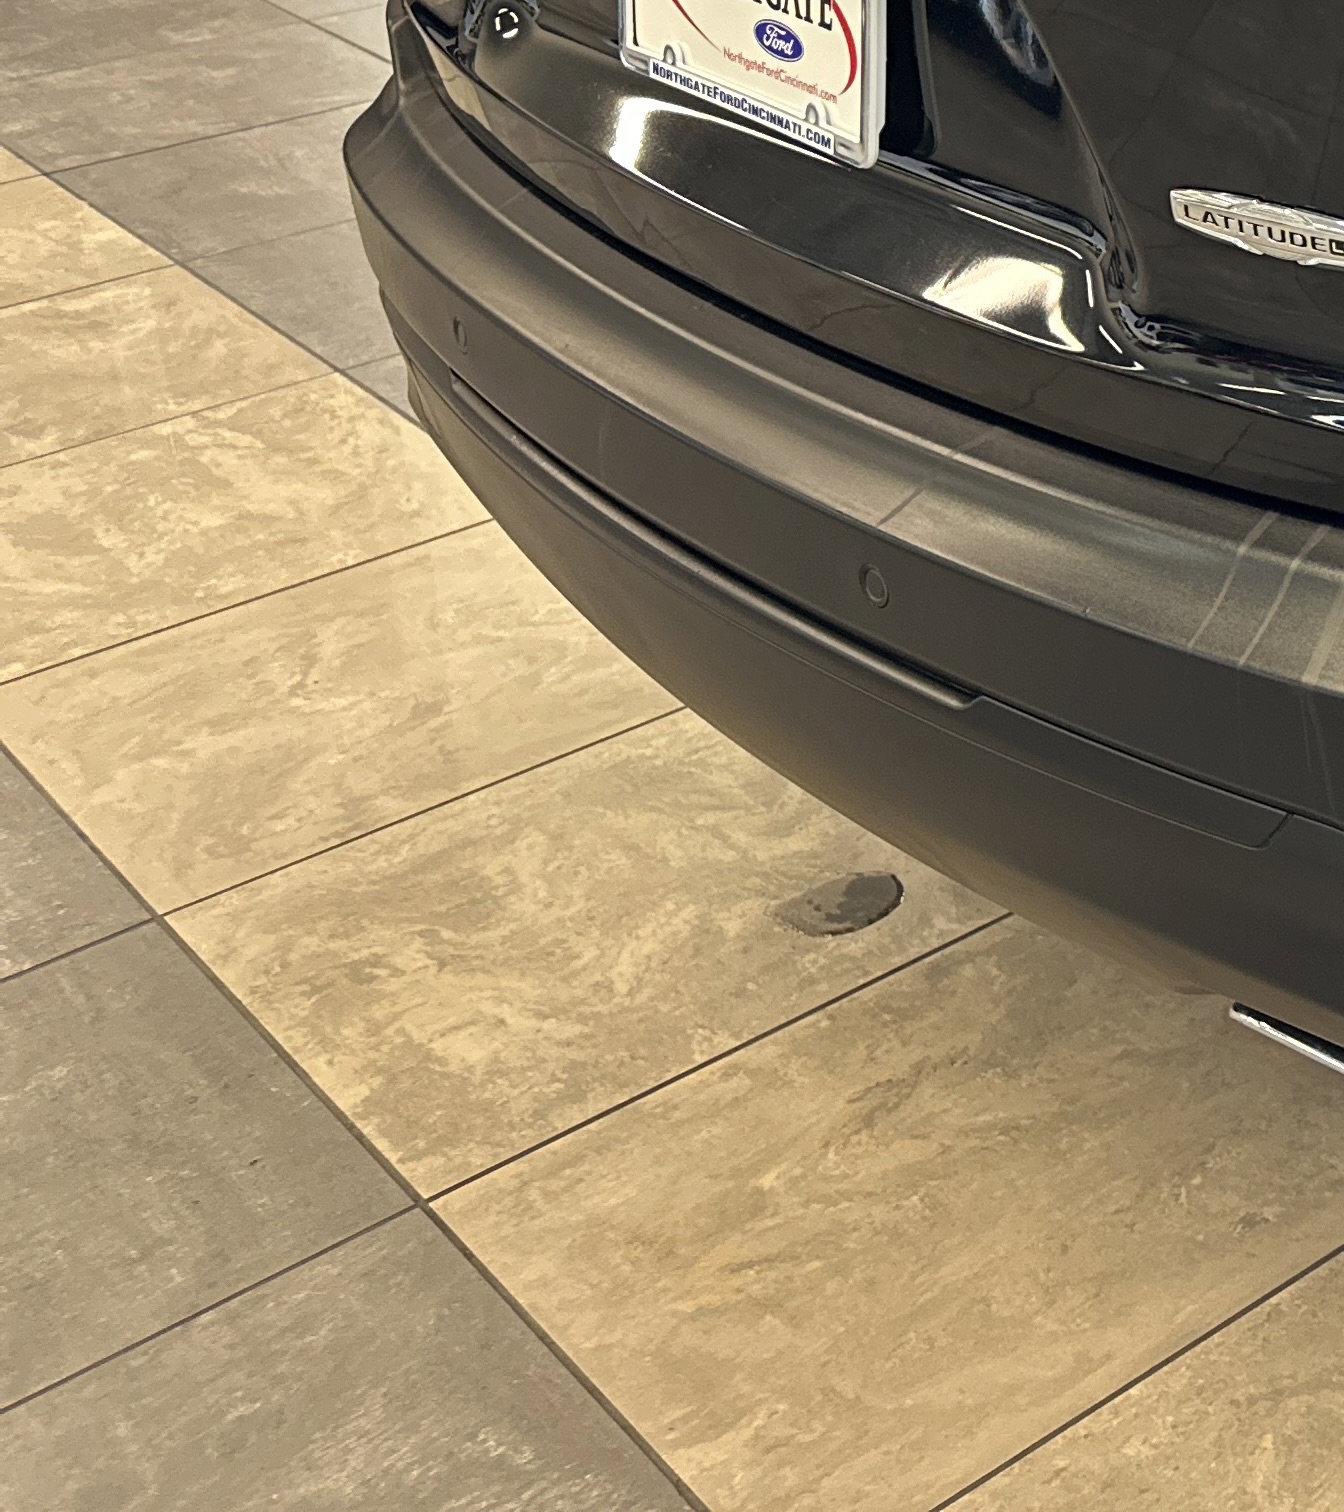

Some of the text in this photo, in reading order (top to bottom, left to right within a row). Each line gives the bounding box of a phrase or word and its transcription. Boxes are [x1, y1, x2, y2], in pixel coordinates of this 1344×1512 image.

[762, 23, 794, 56] Ford
[723, 46, 838, 104] NorthgateFordCincinnati.com
[1183, 203, 1328, 253] LATITUDE
